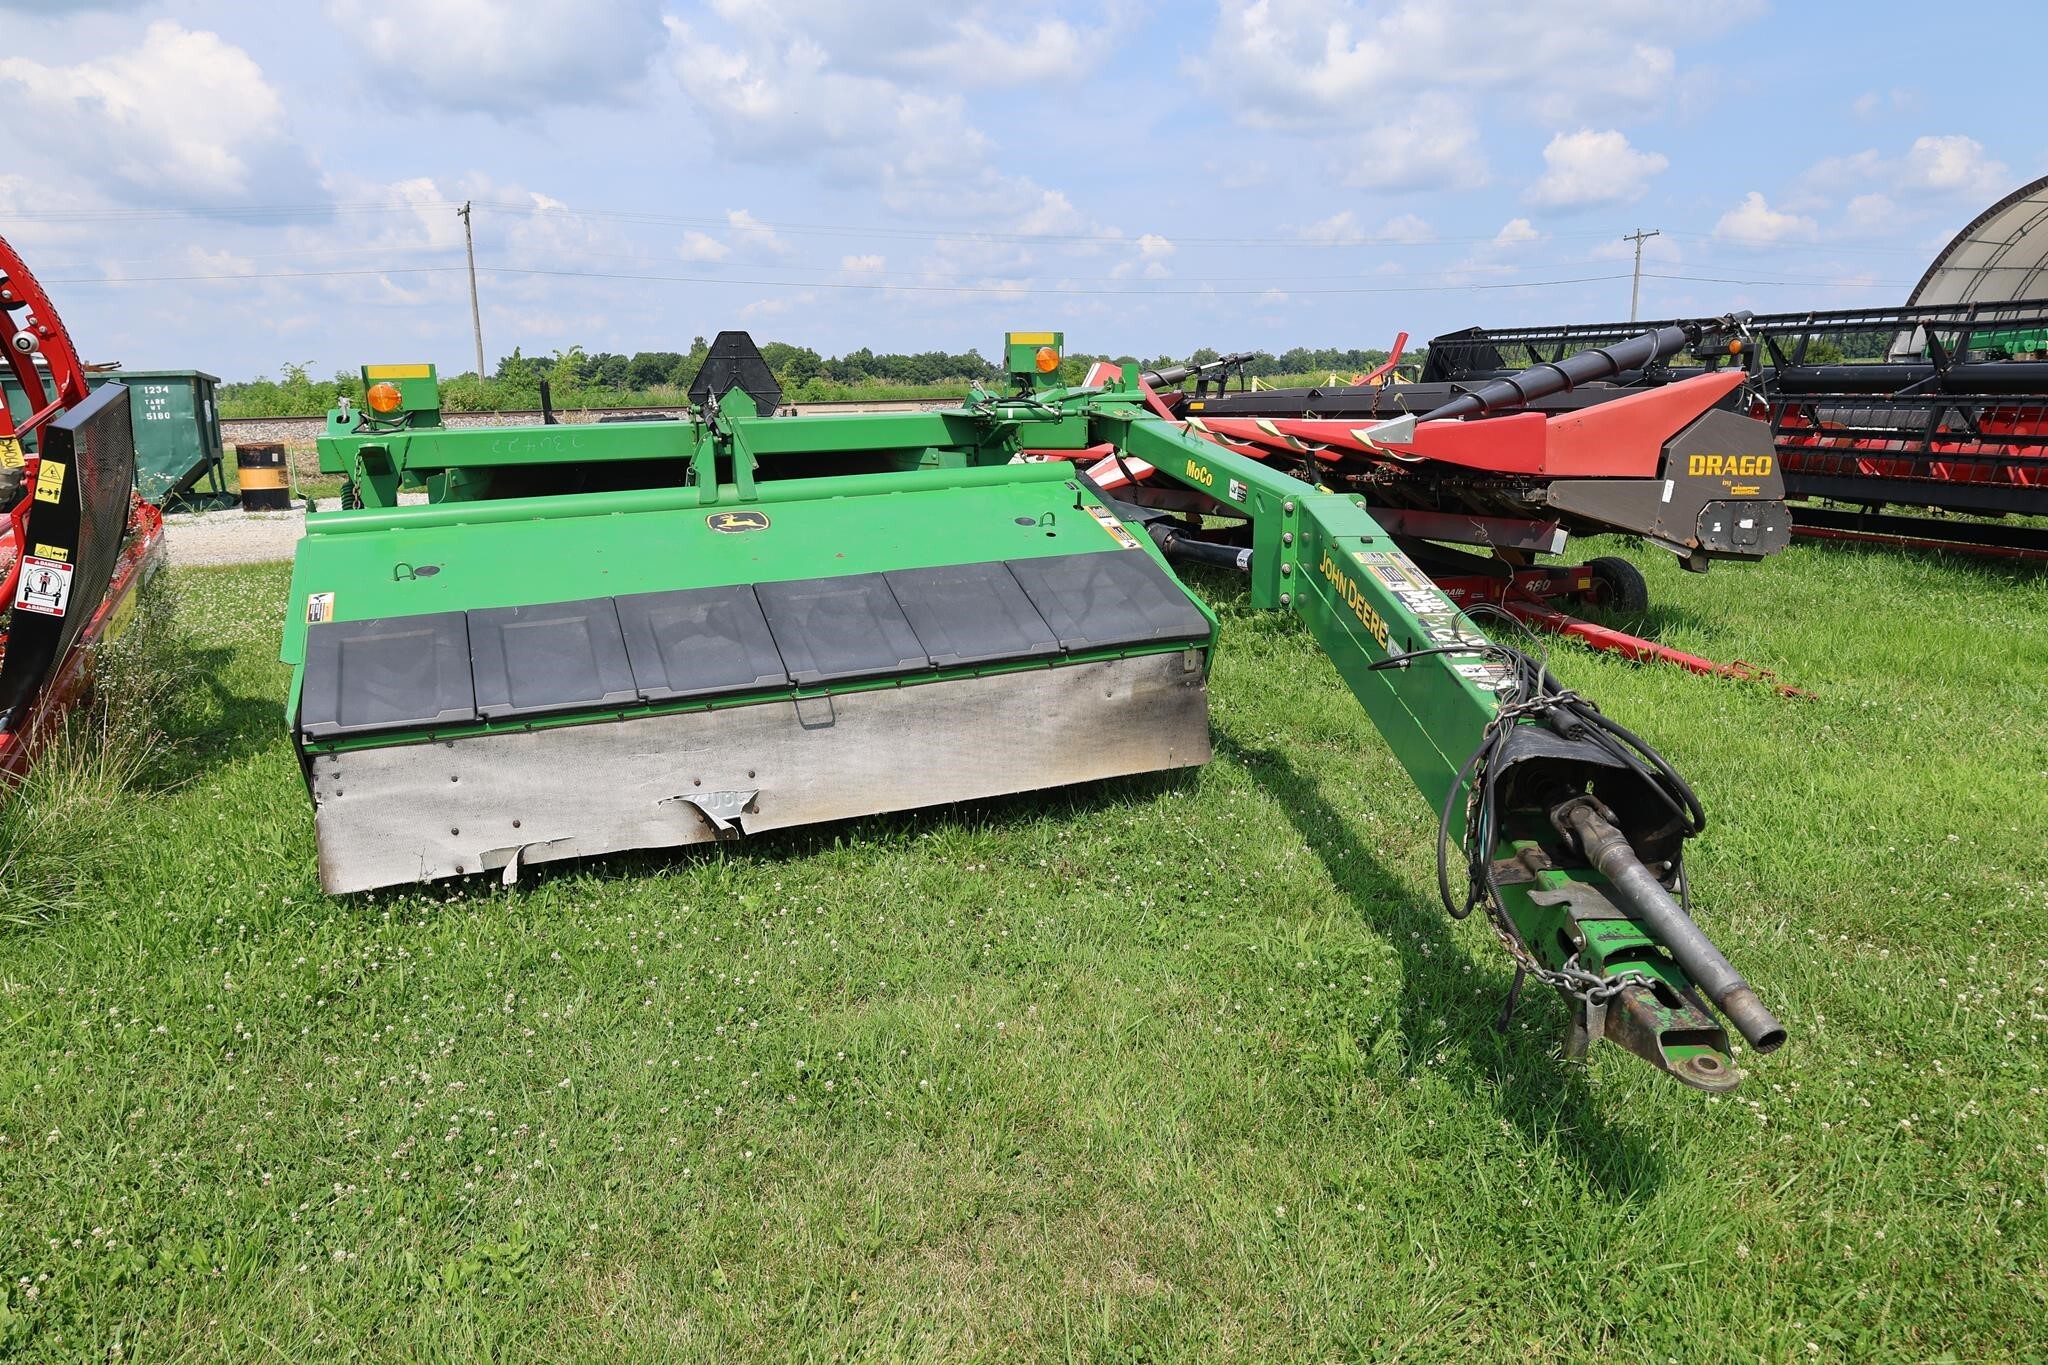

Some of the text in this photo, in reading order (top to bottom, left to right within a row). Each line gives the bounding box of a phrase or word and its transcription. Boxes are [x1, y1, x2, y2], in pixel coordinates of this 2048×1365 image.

[144, 386, 169, 394] 1234
[1186, 459, 1213, 487] MoCo
[1688, 455, 1773, 476] DRAGO
[40, 560, 63, 569] DANGER
[1319, 549, 1347, 600] JOHN
[1347, 579, 1389, 650] DEERE
[31, 604, 55, 613] DANGER
